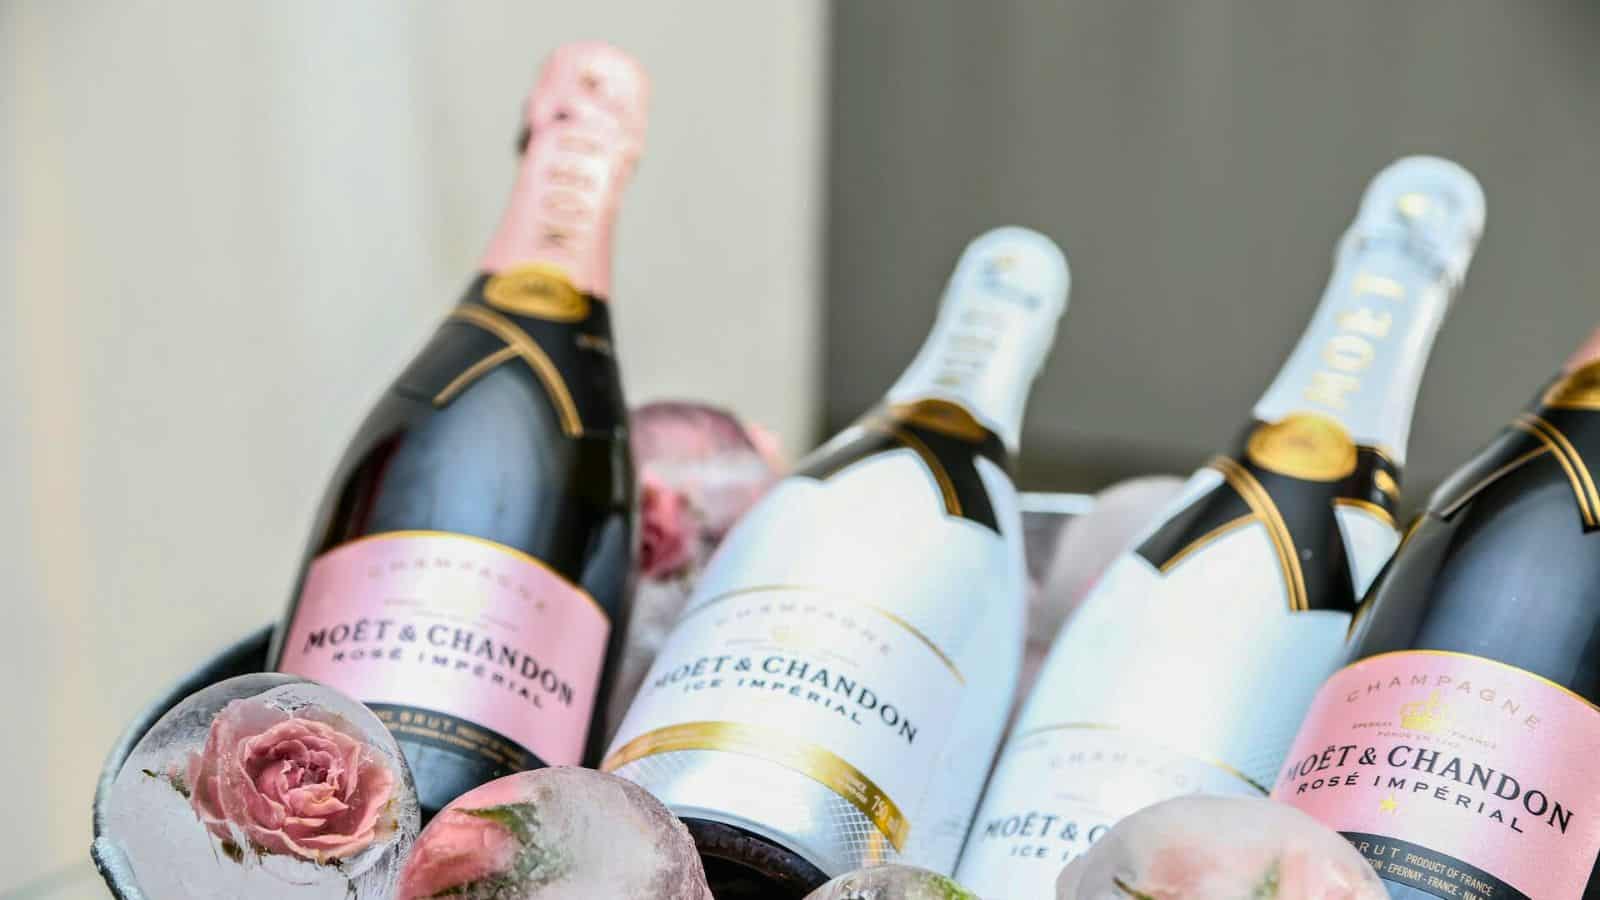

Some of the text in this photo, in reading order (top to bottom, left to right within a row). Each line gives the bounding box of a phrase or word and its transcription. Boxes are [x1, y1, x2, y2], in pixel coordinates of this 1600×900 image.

[331, 647, 545, 709] ROSÉ IMPÉRIAL
[399, 624, 418, 643] &
[427, 624, 577, 707] CHANDON
[399, 711, 453, 732] BRUT
[683, 678, 863, 726] ICE IMPÉRIAL
[734, 656, 752, 672] &
[763, 655, 920, 745] CHANDON
[1345, 674, 1543, 730] CHAMPAGNE
[1286, 744, 1575, 836] MOËT & CHANDON
[1296, 771, 1524, 834] ROSÉ IMPÉRIAL
[1009, 845, 1049, 859] ICE
[1060, 822, 1078, 842] &
[1387, 862, 1425, 881] EPERNAY
[1427, 876, 1460, 896] FRANCE
[1405, 853, 1447, 876] PRODUCT
[1446, 866, 1460, 879] OF
[1459, 873, 1495, 897] FRANCE
